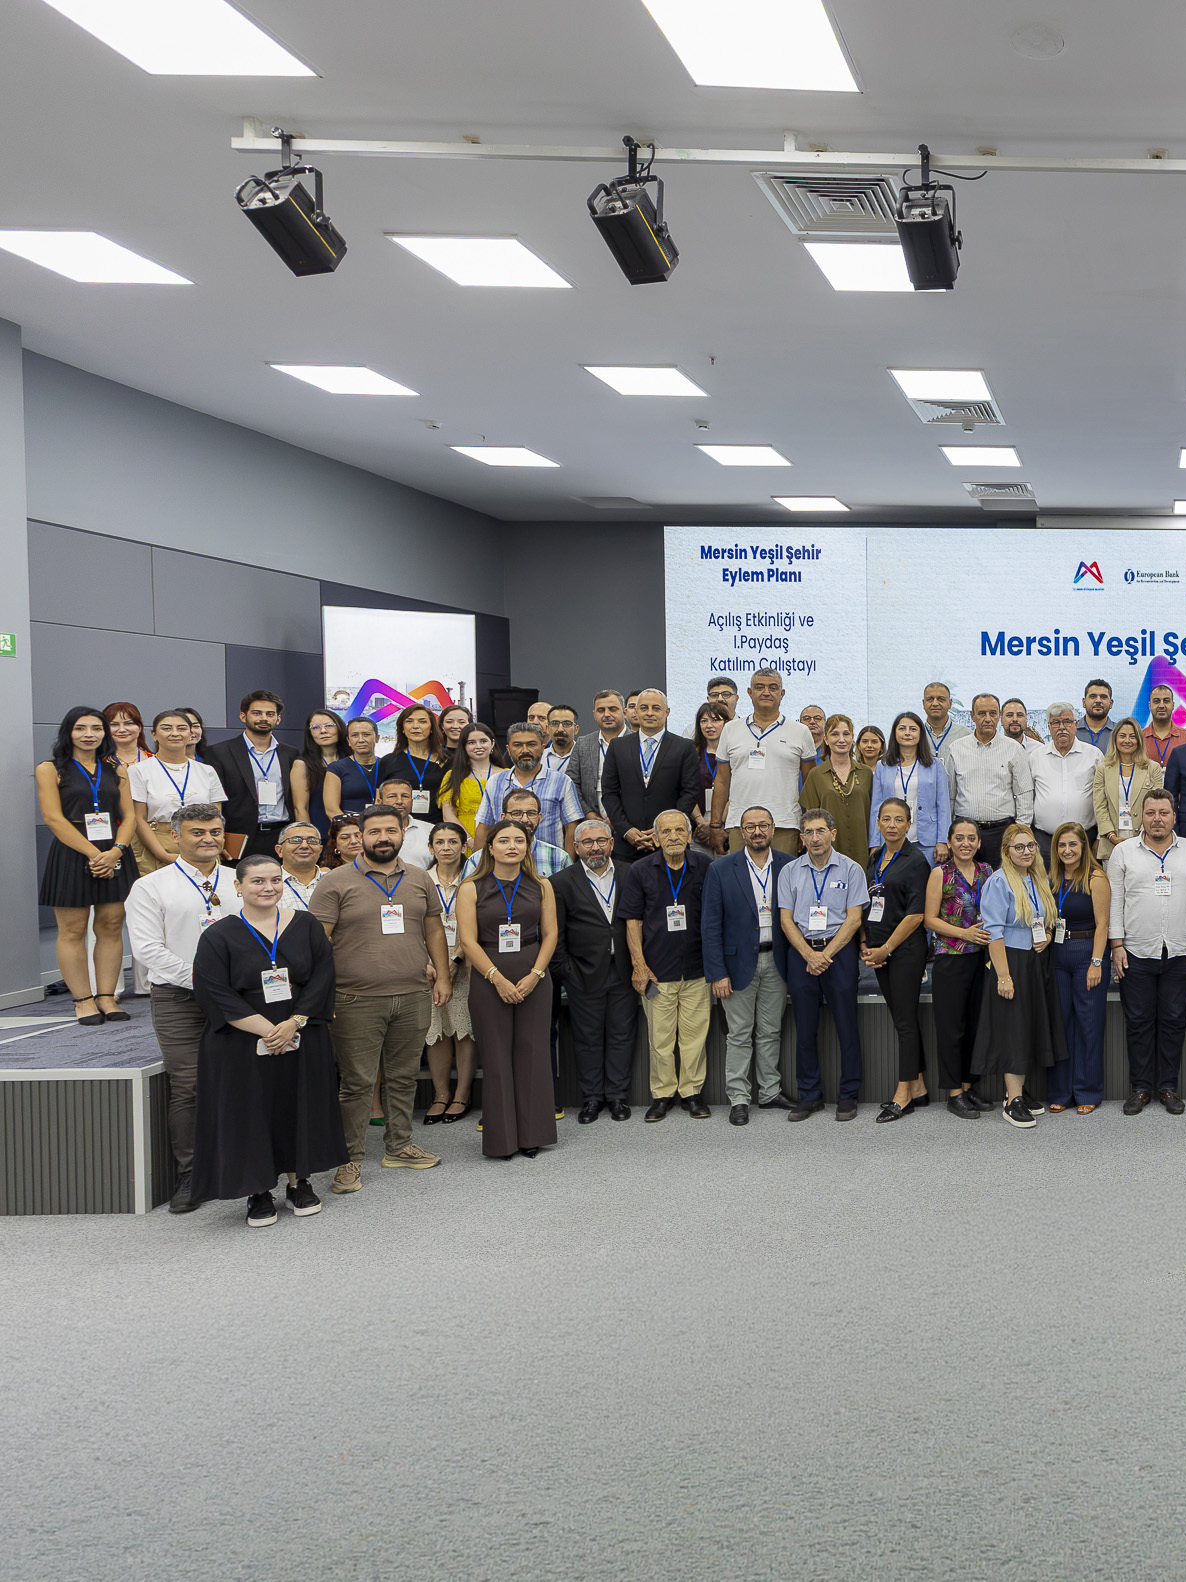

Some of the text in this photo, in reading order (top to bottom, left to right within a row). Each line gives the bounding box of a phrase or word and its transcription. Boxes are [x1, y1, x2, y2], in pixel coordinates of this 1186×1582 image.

[700, 543, 822, 565] Mersin Yeşil Şehir
[722, 567, 802, 587] Eylem Planı
[1136, 570, 1180, 579] European Bank
[708, 612, 814, 632] Açılış Etkinliği ve
[733, 634, 789, 653] I.Paydaş
[980, 628, 1080, 657] Mersin
[1087, 629, 1156, 665] Yeşil
[710, 657, 755, 671] Katılım
